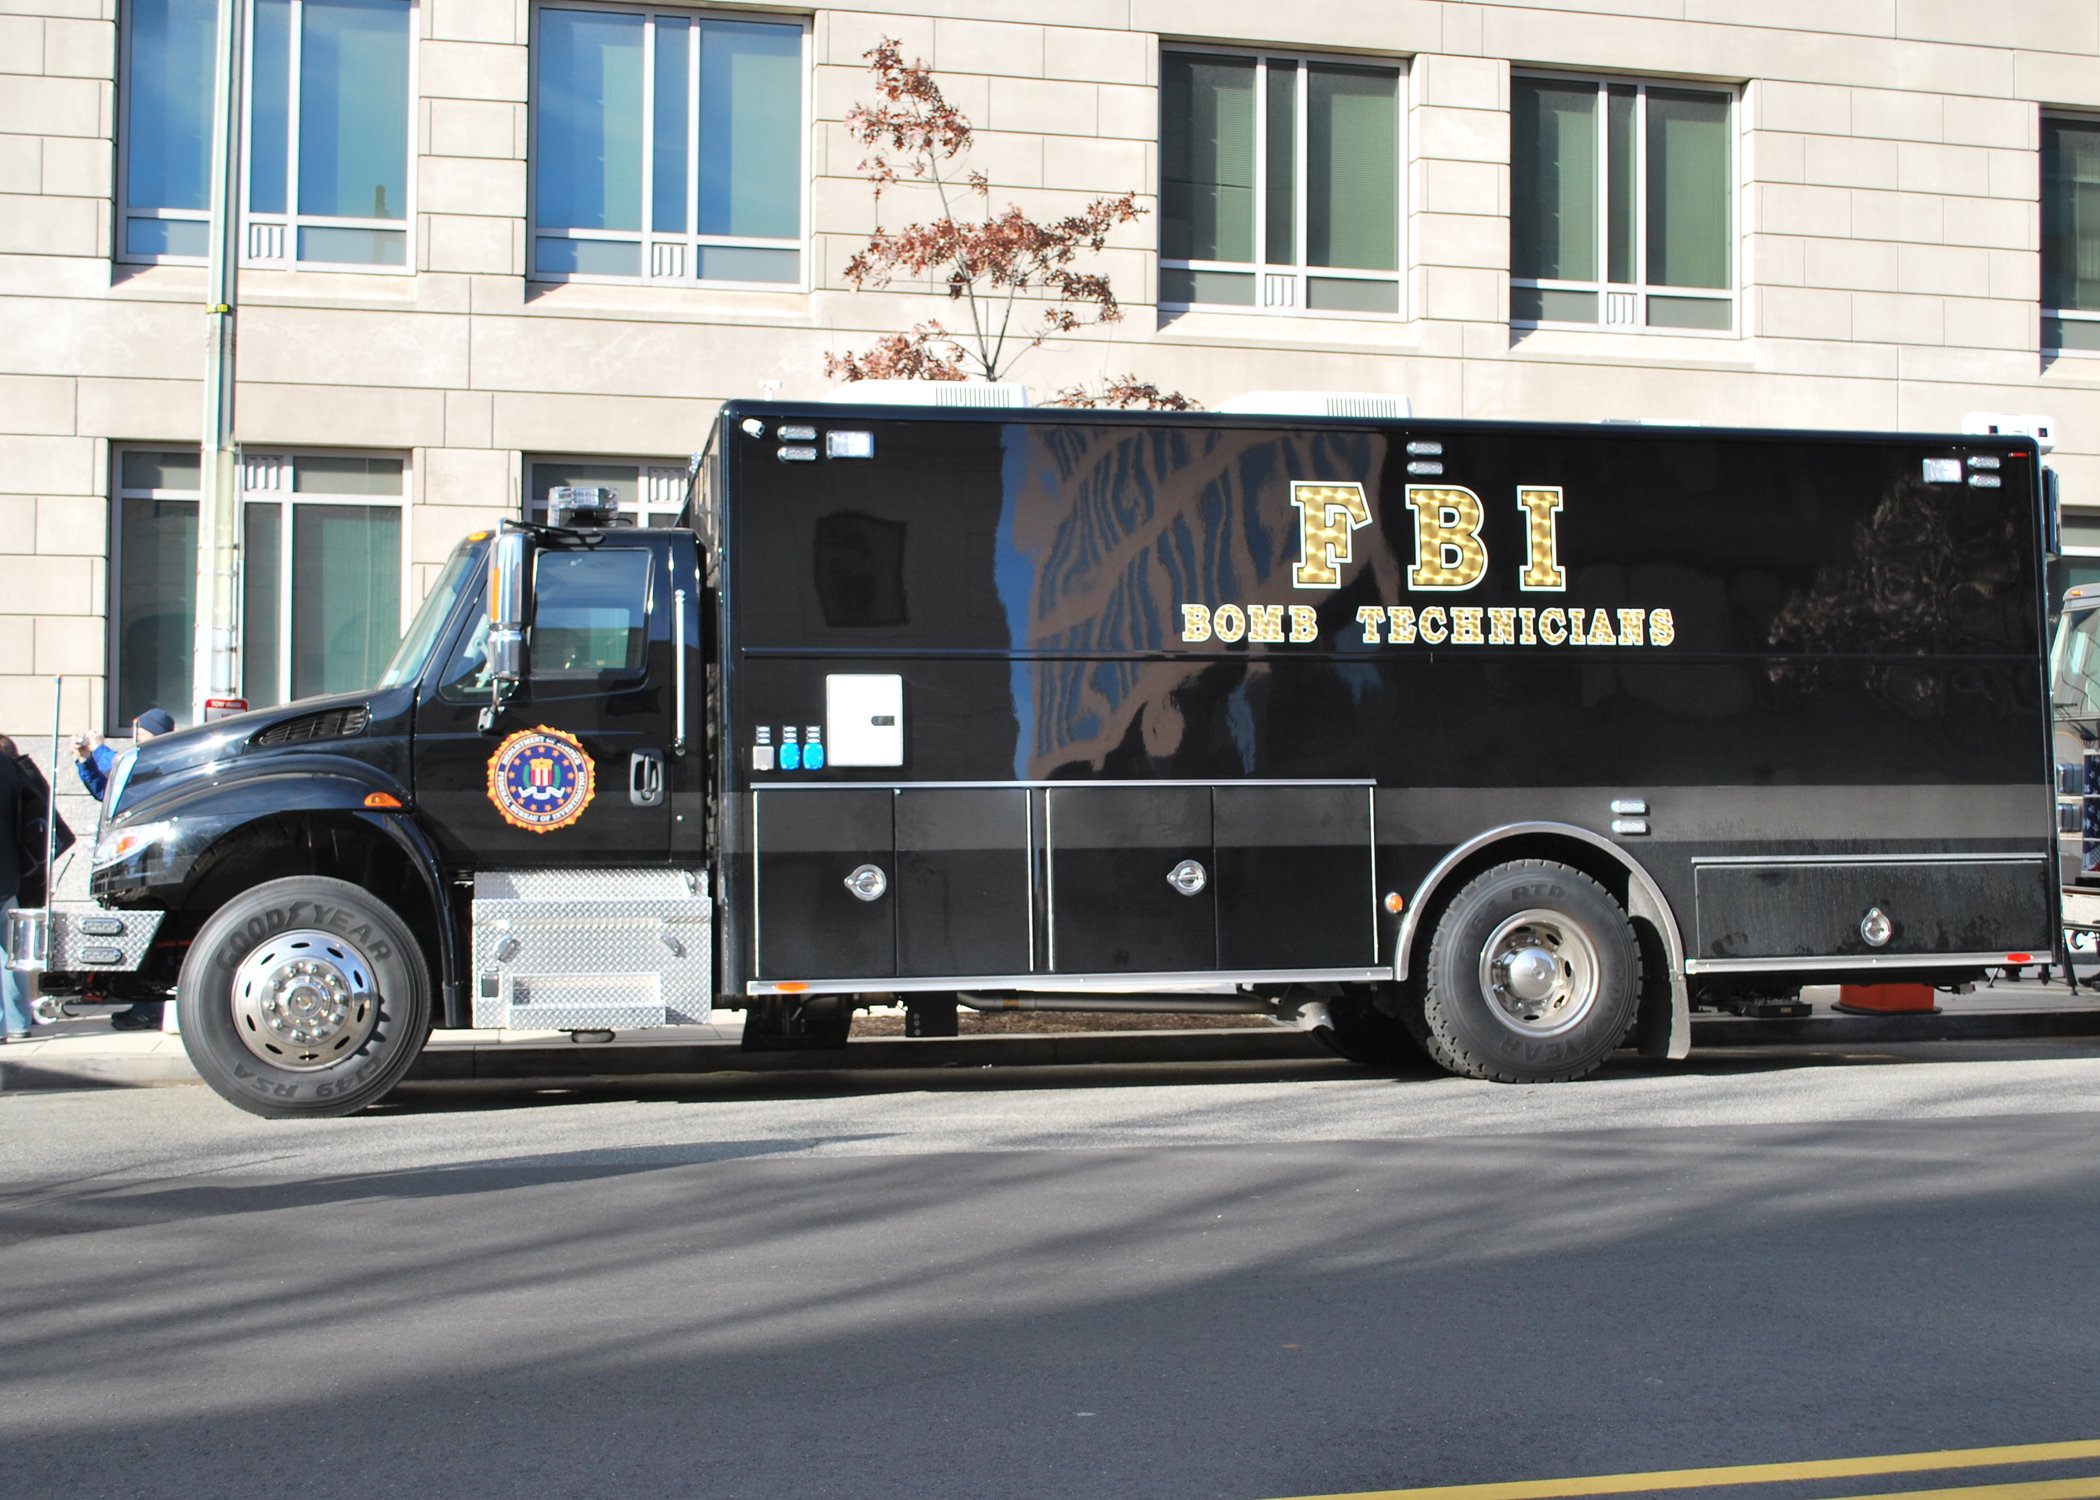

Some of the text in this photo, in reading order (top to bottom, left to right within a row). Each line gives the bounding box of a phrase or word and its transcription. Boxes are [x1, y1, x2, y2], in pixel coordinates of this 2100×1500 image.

[1289, 480, 1567, 592] FBI
[1181, 604, 1676, 646] BOMB TECHNICIANS
[502, 735, 581, 765] DEPARTMENT OF JUSTICE
[498, 771, 512, 807] FEDERAL
[510, 805, 538, 822] BUREAU
[540, 814, 551, 822] OF
[552, 771, 585, 820] INVESTIGATION
[215, 901, 393, 971] GOODYEAR
[233, 1061, 298, 1098] RSA
